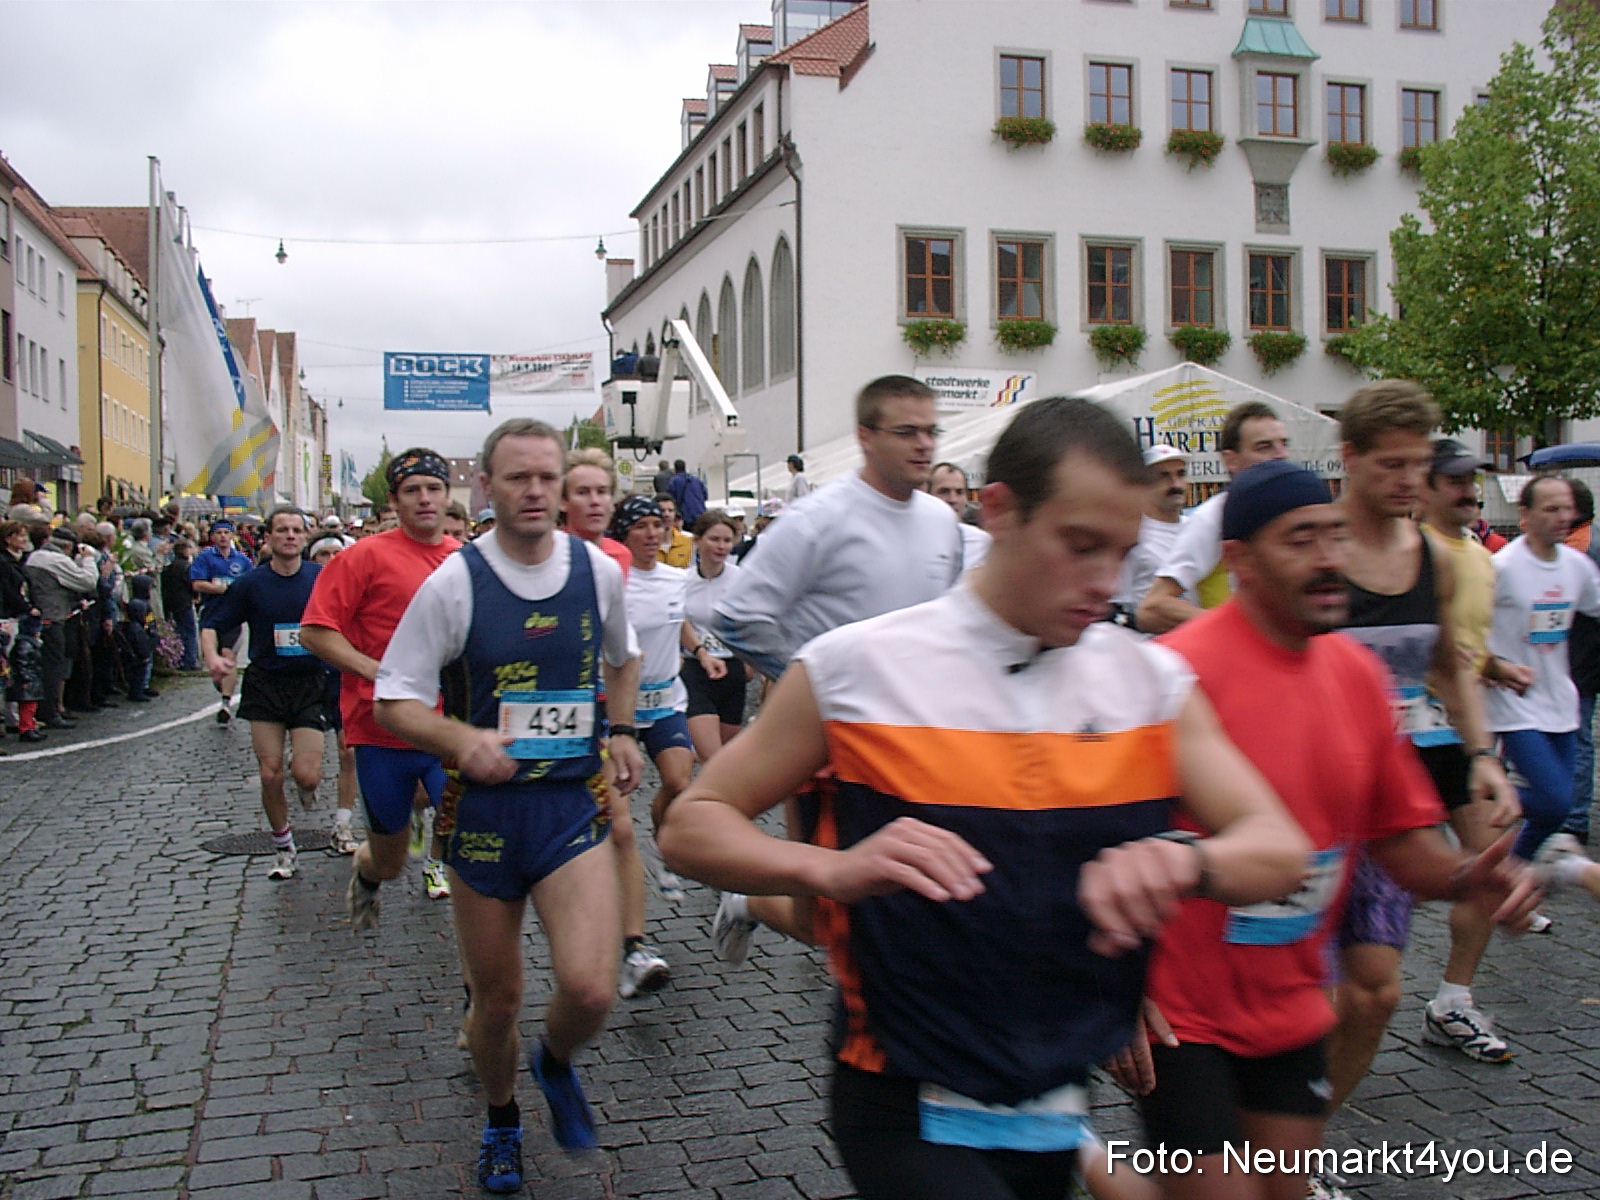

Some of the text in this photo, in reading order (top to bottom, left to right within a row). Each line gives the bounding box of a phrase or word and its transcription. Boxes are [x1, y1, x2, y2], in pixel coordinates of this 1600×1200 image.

[390, 356, 483, 377] BOCK
[925, 376, 990, 388] stadtwerke
[939, 389, 978, 399] markt
[528, 707, 577, 735] 434
